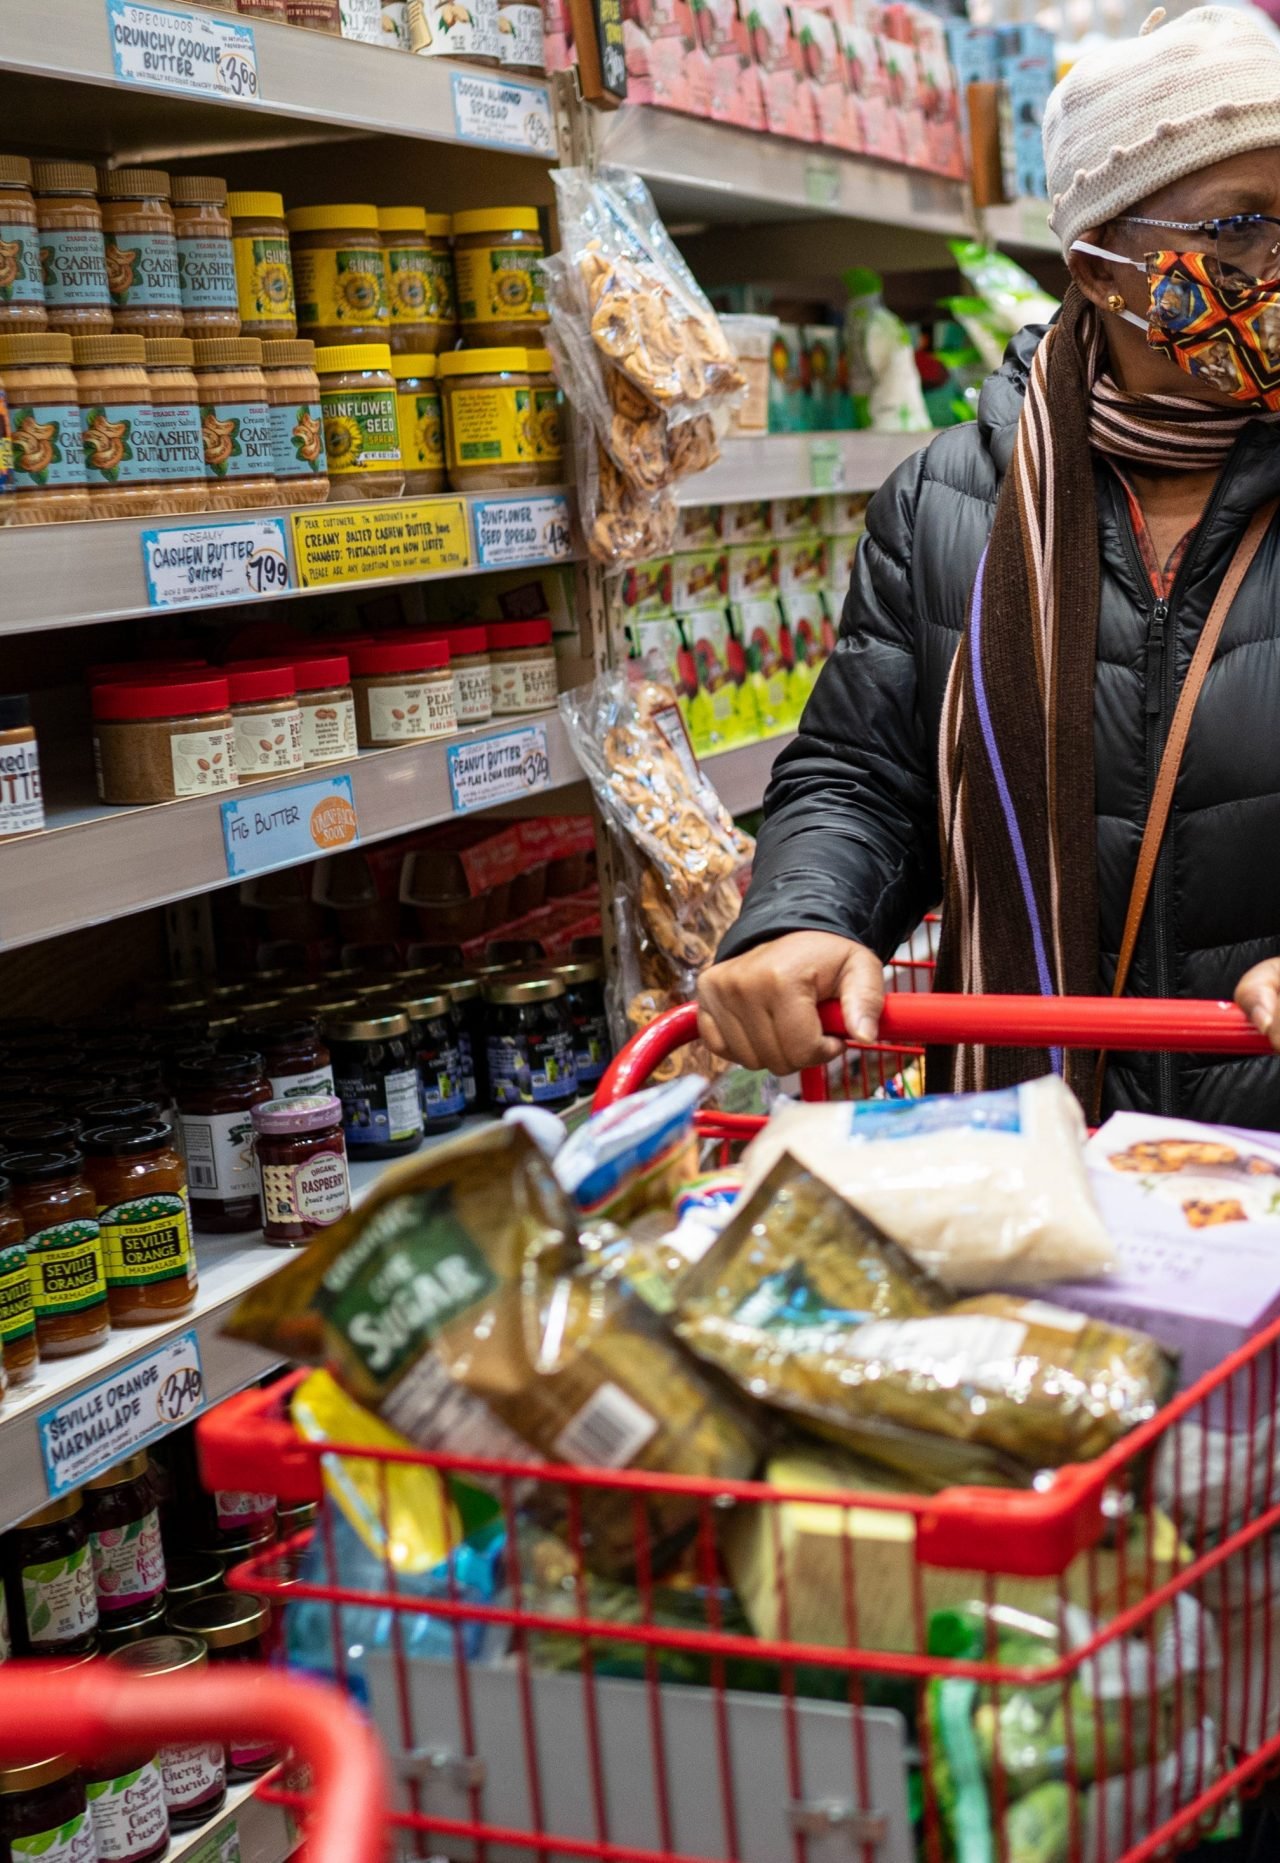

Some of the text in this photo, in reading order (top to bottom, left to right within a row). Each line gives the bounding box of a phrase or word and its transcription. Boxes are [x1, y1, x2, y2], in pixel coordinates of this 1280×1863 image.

[131, 9, 193, 33] SPECULOOS
[114, 24, 222, 65] CRUNCHY COOKIE
[143, 52, 195, 77] BUTTER
[470, 99, 508, 120] SPREAD
[323, 400, 393, 417] SUNFLOWER
[367, 418, 394, 433] SEED
[156, 431, 200, 446] ASHEW
[159, 447, 203, 463] UTTER
[304, 519, 320, 529] DEAR
[481, 506, 533, 525] SUNFLOWER
[182, 530, 225, 544] CREAMY
[304, 522, 450, 549] CREAMY SALTED CASHEW BUTTER have
[481, 527, 537, 546] SEED SPREAD
[153, 540, 256, 569] CASHEW BUTTER
[346, 543, 387, 560] PISTACHIOS
[389, 545, 401, 556] are
[403, 541, 419, 553] NOW
[308, 567, 329, 580] PLEASE
[332, 566, 343, 577] ASK
[347, 564, 359, 574] ANY
[361, 559, 389, 573] QUESTIONS
[391, 558, 401, 568] YOU
[430, 723, 442, 731] FLAX
[454, 746, 521, 778] PEANUT BUTTER
[488, 769, 502, 783] CHIA
[230, 806, 301, 841] FIG BUTTER
[323, 825, 346, 842] SOON
[311, 1165, 337, 1177] ORGANIC
[302, 1173, 344, 1194] RASPBERRY
[305, 1194, 323, 1207] fruit
[125, 1221, 172, 1234] TRADER JOE'S
[125, 1230, 174, 1250] SEVILLE
[46, 1251, 74, 1260] TRADER
[126, 1245, 177, 1264] ORANGE
[47, 1256, 93, 1277] SEVILLE
[129, 1258, 178, 1274] MARMALADE
[47, 1271, 96, 1291] ORANGE
[0, 1281, 31, 1303] EVILLE
[50, 1285, 96, 1302] MARMALADE
[50, 1365, 159, 1440] SEVILLE ORANGE
[51, 1397, 141, 1464] MARMALADE
[162, 1764, 203, 1784] Cherry
[164, 1776, 211, 1796] reserves
[128, 1806, 161, 1829] Cherry
